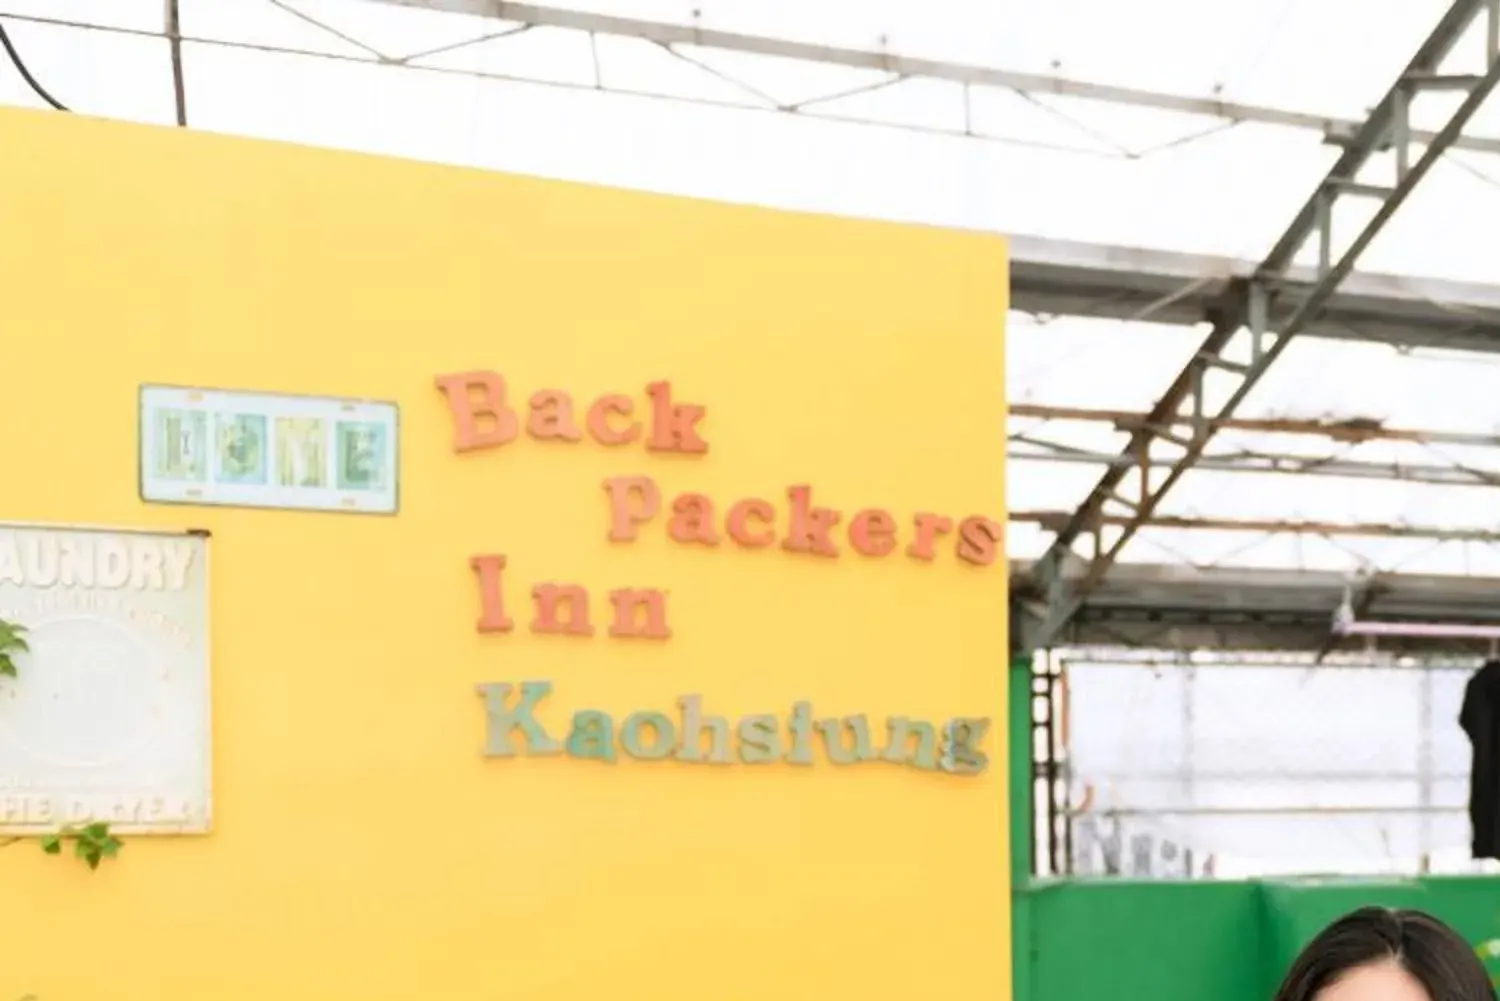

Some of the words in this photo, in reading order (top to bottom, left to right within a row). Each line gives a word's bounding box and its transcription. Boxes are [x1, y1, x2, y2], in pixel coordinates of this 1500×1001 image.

[435, 370, 709, 454] Back
[602, 474, 1002, 567] Packers
[469, 554, 672, 639] Inn
[476, 681, 991, 775] Kaohsiung
